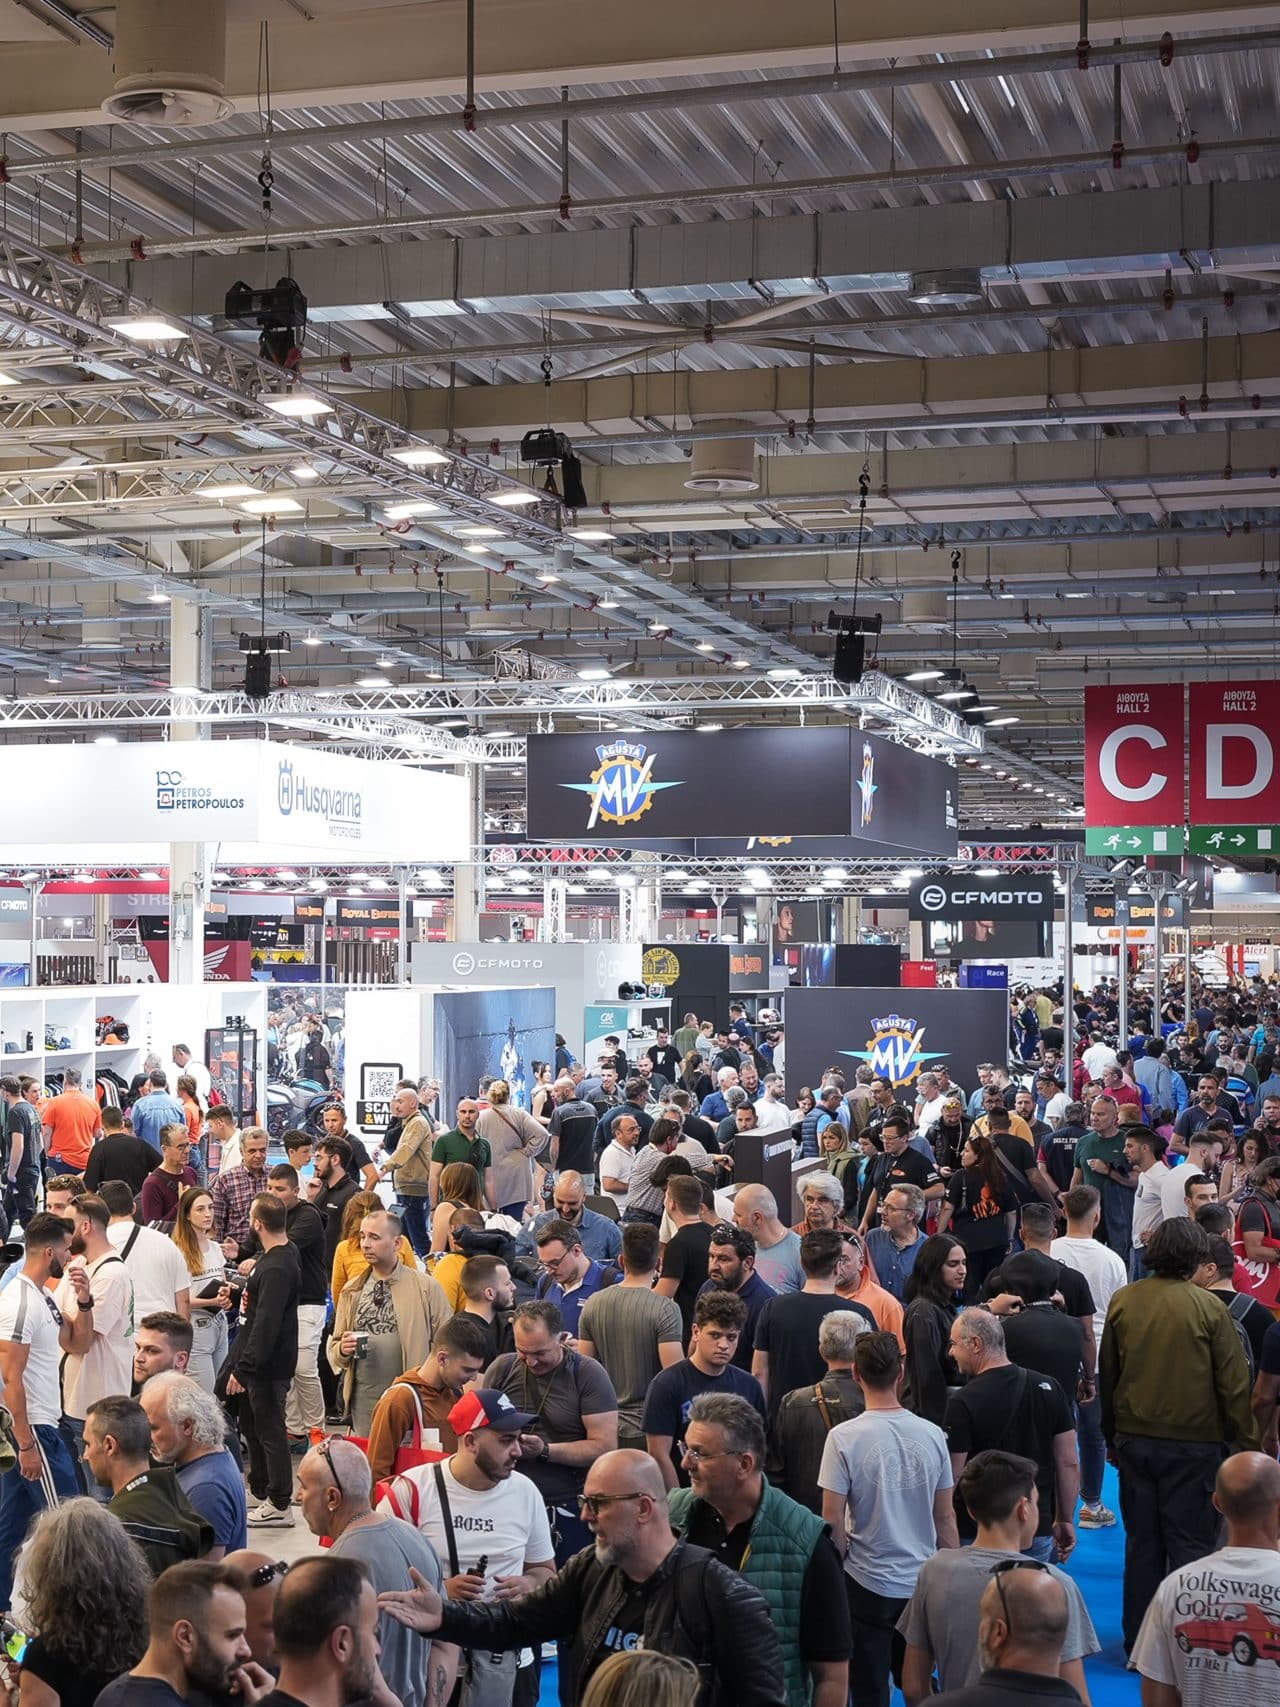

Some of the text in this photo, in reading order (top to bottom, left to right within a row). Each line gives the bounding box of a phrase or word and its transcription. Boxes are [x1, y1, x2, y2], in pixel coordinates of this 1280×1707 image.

[1116, 693, 1150, 703] ΑΙΘΟΥΣΑ
[1223, 691, 1256, 701] ΑΙΘΟΥΣΑ
[1116, 703, 1150, 714] HALL 2
[1223, 701, 1257, 711] HALL 2
[602, 745, 641, 756] AGUSTA
[1099, 724, 1167, 802] C
[1206, 724, 1274, 799] D
[176, 788, 212, 797] PETROS
[586, 753, 658, 830] MV
[295, 775, 361, 820] Husqvarna
[176, 798, 244, 809] PETROPOULOS
[951, 891, 1042, 905] CFMOTO
[478, 959, 543, 968] CFMOTO
[987, 969, 1004, 977] Race
[876, 1019, 911, 1029] AGUSTA
[870, 1027, 926, 1082] MV
[365, 1102, 391, 1113] SCA
[365, 1113, 392, 1124] &WI
[453, 1515, 494, 1532] BOSS
[1179, 1571, 1280, 1605] Volkswage
